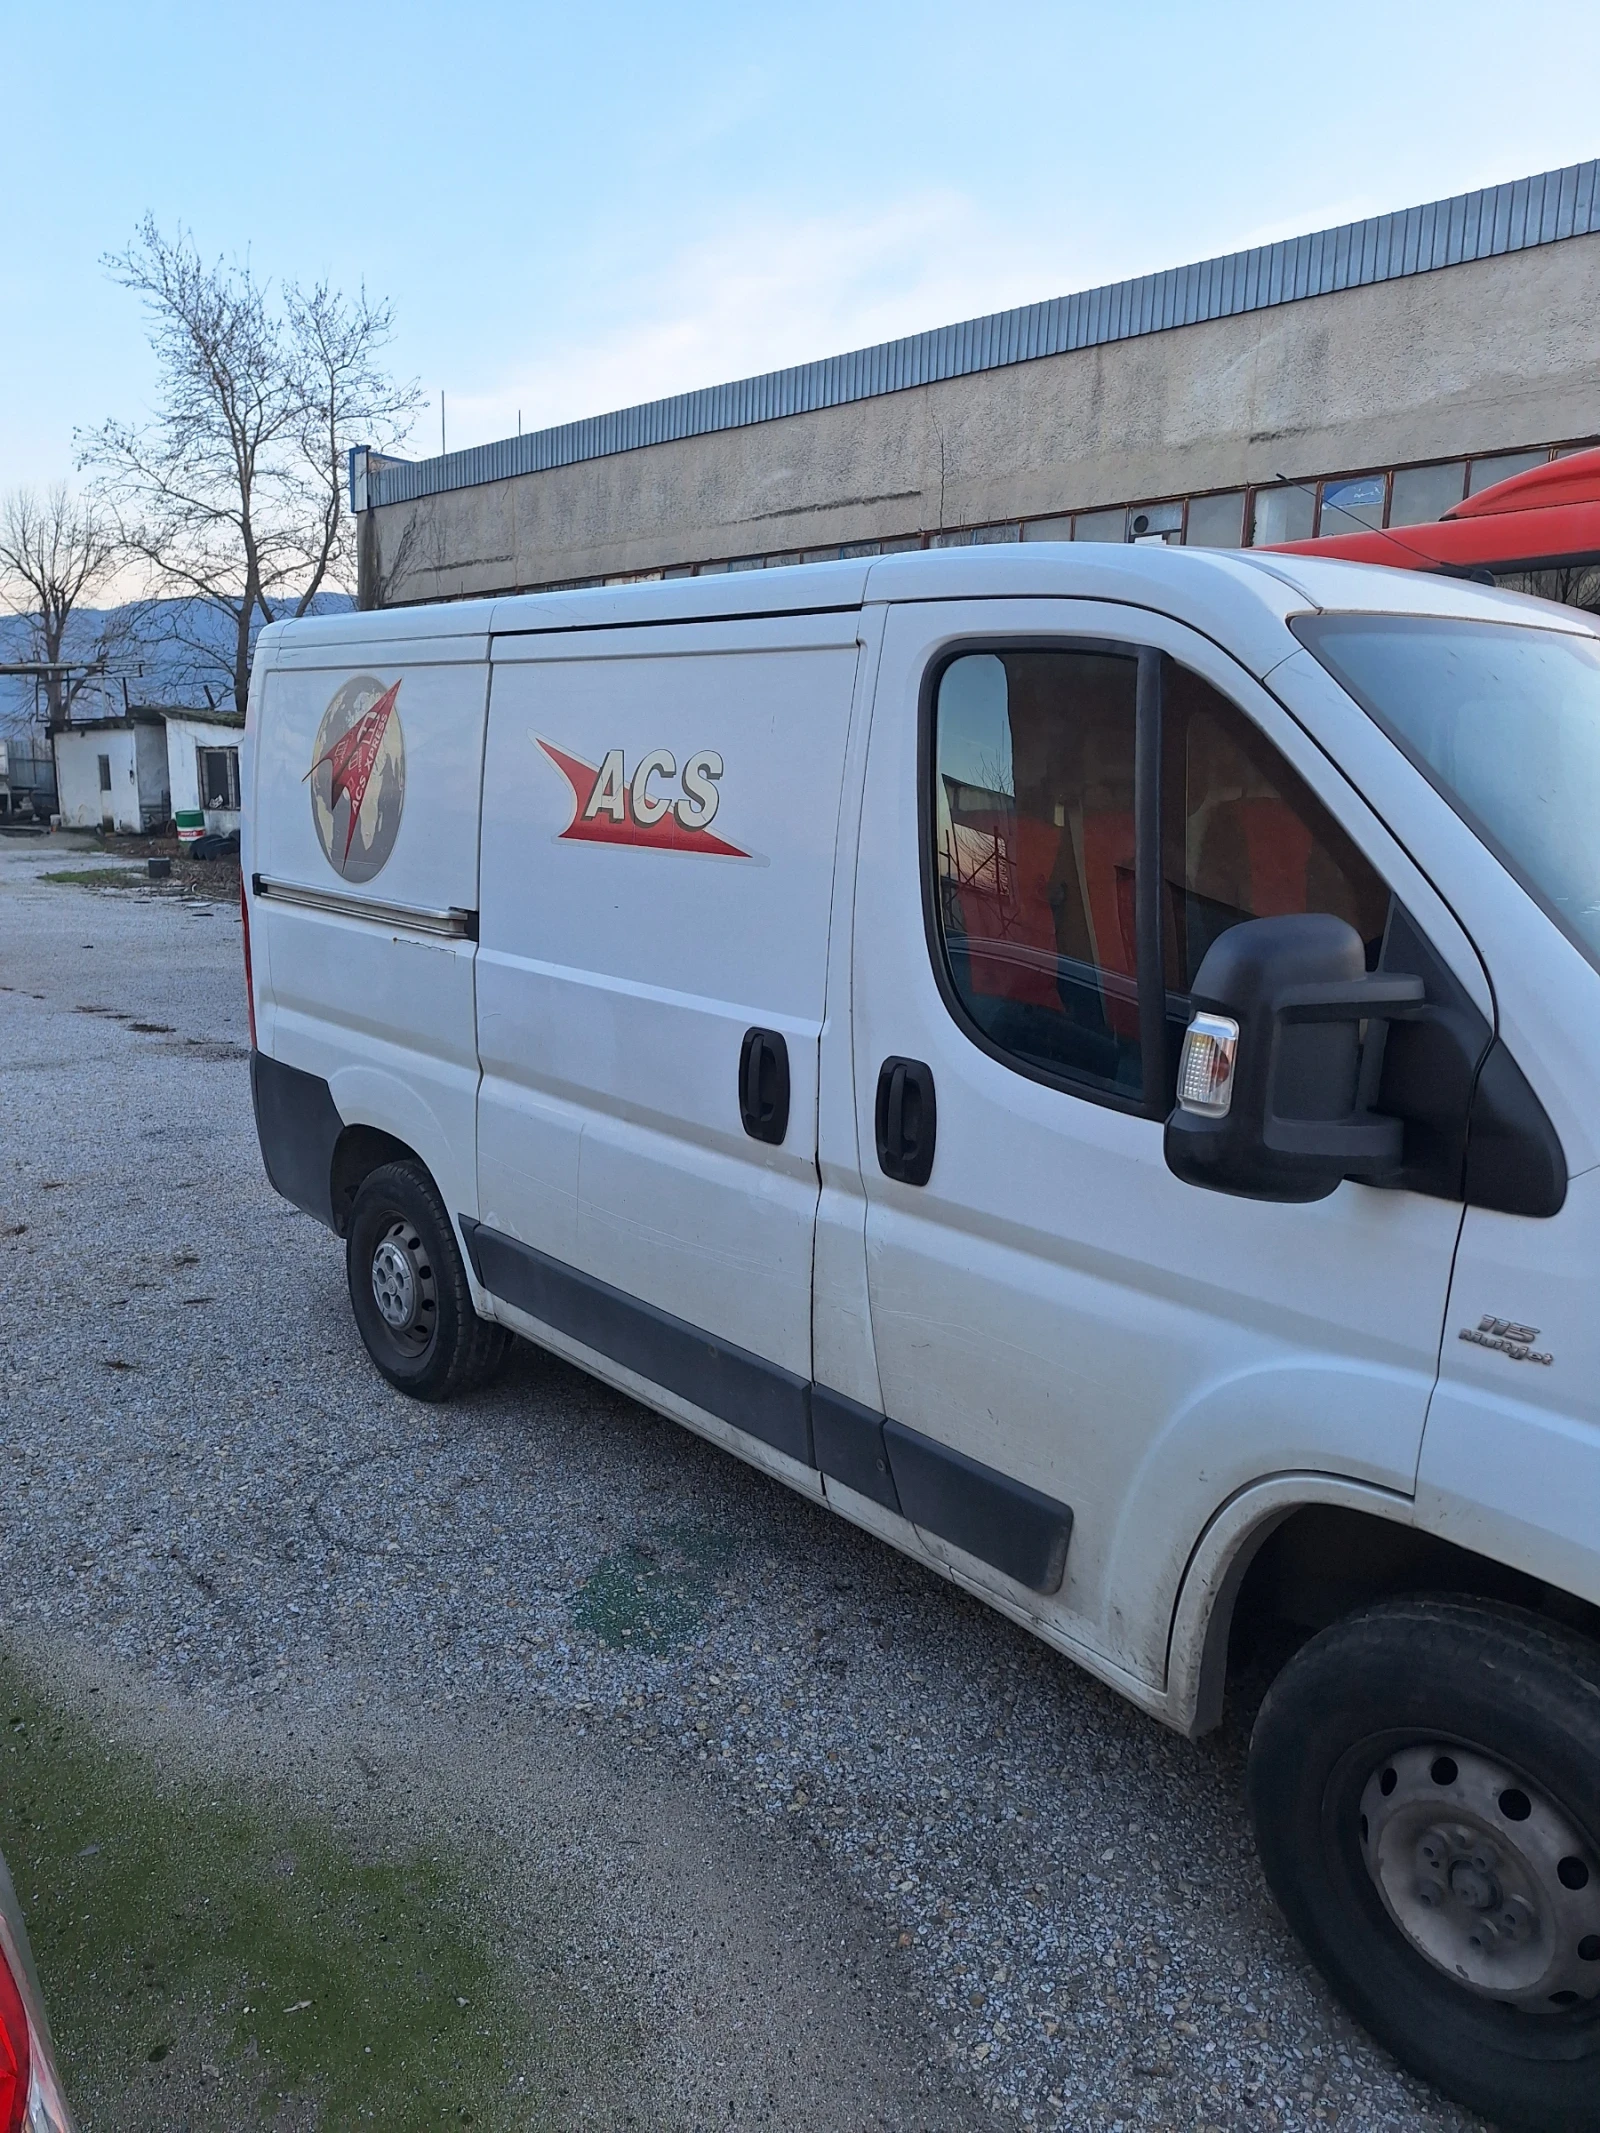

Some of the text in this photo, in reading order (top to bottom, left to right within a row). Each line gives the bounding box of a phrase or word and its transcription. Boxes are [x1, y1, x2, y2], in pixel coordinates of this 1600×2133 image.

[352, 713, 388, 814] ACS XPRESS
[582, 748, 724, 832] ACS
[1477, 1314, 1541, 1344] 115
